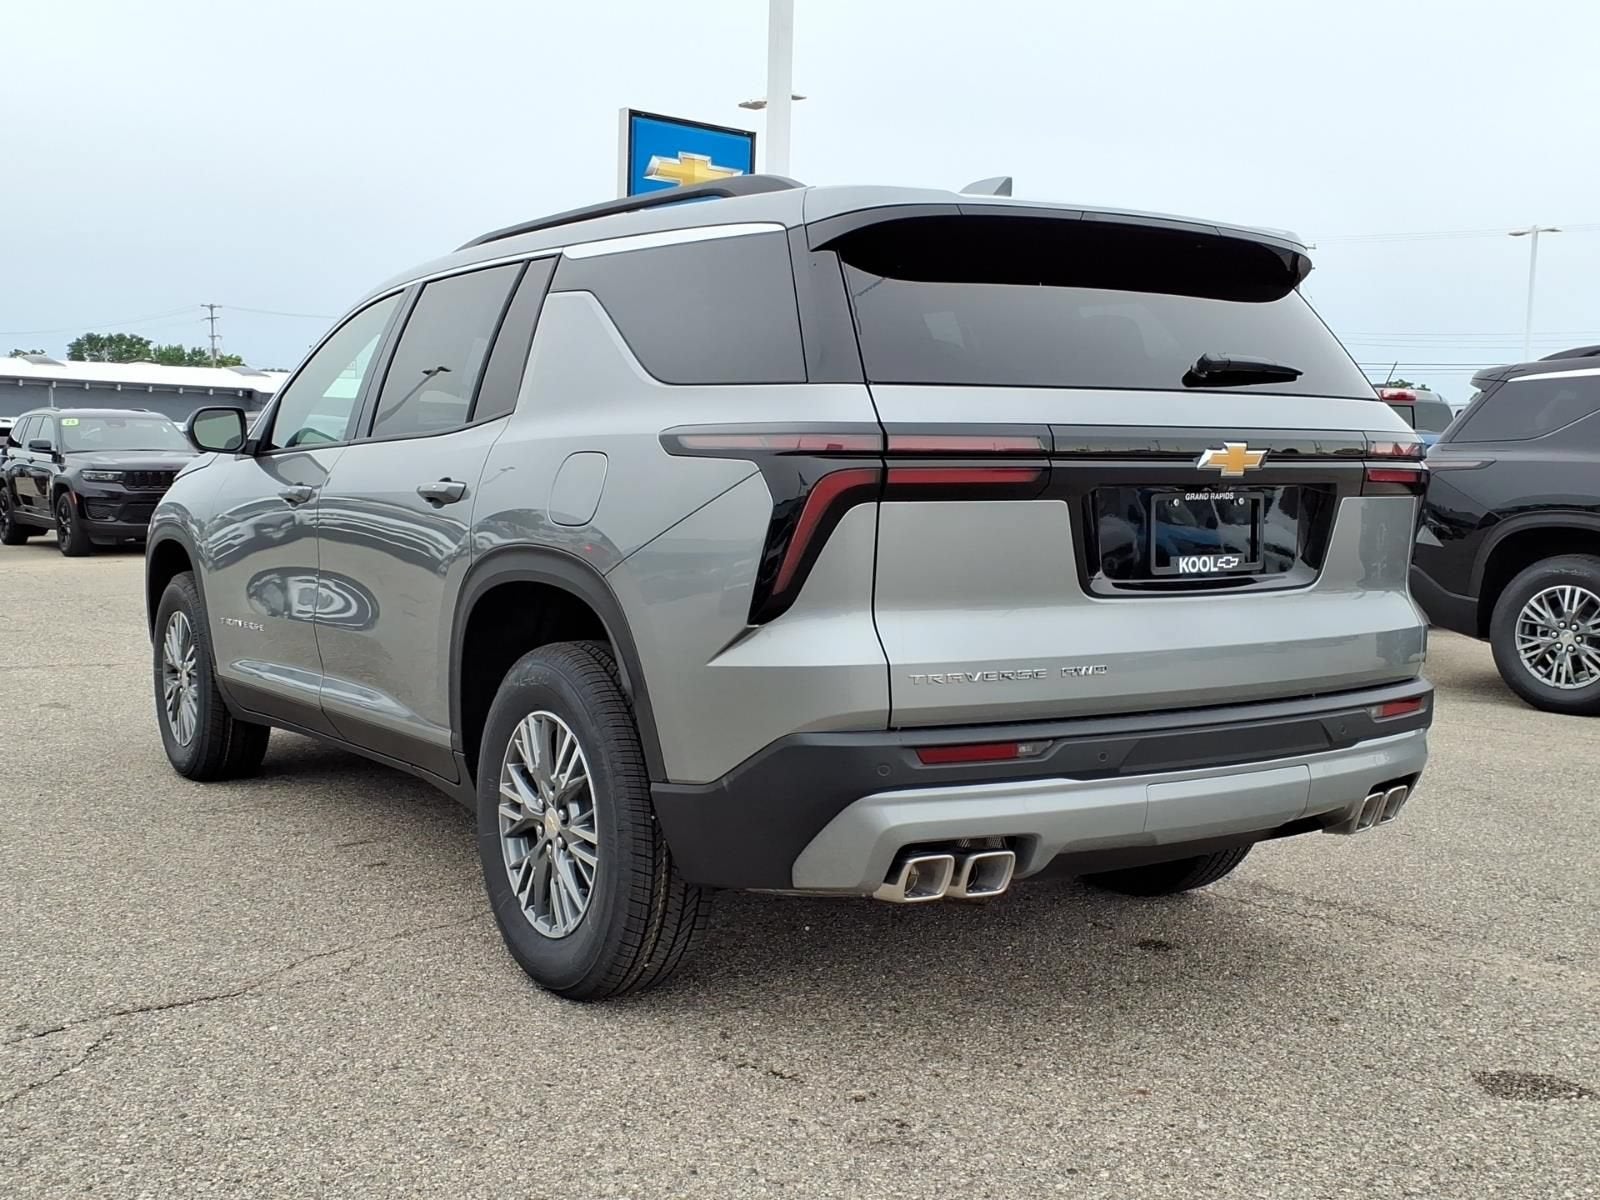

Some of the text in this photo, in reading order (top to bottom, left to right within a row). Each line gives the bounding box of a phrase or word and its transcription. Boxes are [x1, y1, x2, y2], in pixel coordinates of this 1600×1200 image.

[1185, 491, 1234, 501] GRAND RAPIDS
[1179, 556, 1218, 573] KOOL
[908, 664, 1107, 685] TRAVERSE AWD
